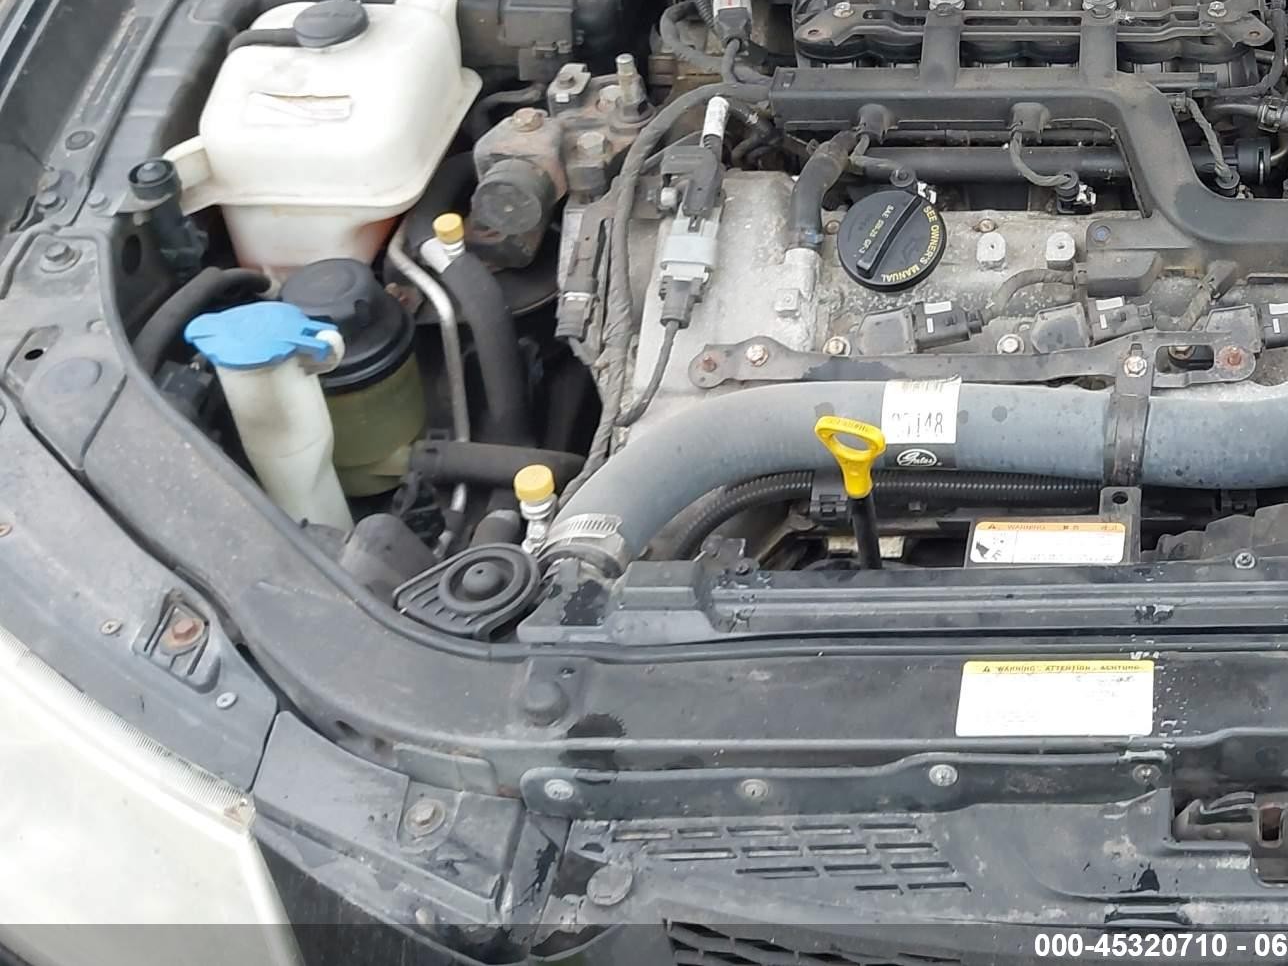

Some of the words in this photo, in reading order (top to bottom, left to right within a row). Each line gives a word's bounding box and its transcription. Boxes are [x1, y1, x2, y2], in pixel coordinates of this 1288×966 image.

[923, 205, 938, 223] SEE
[919, 224, 940, 265] OWNER'S
[880, 264, 920, 283] MANUAL
